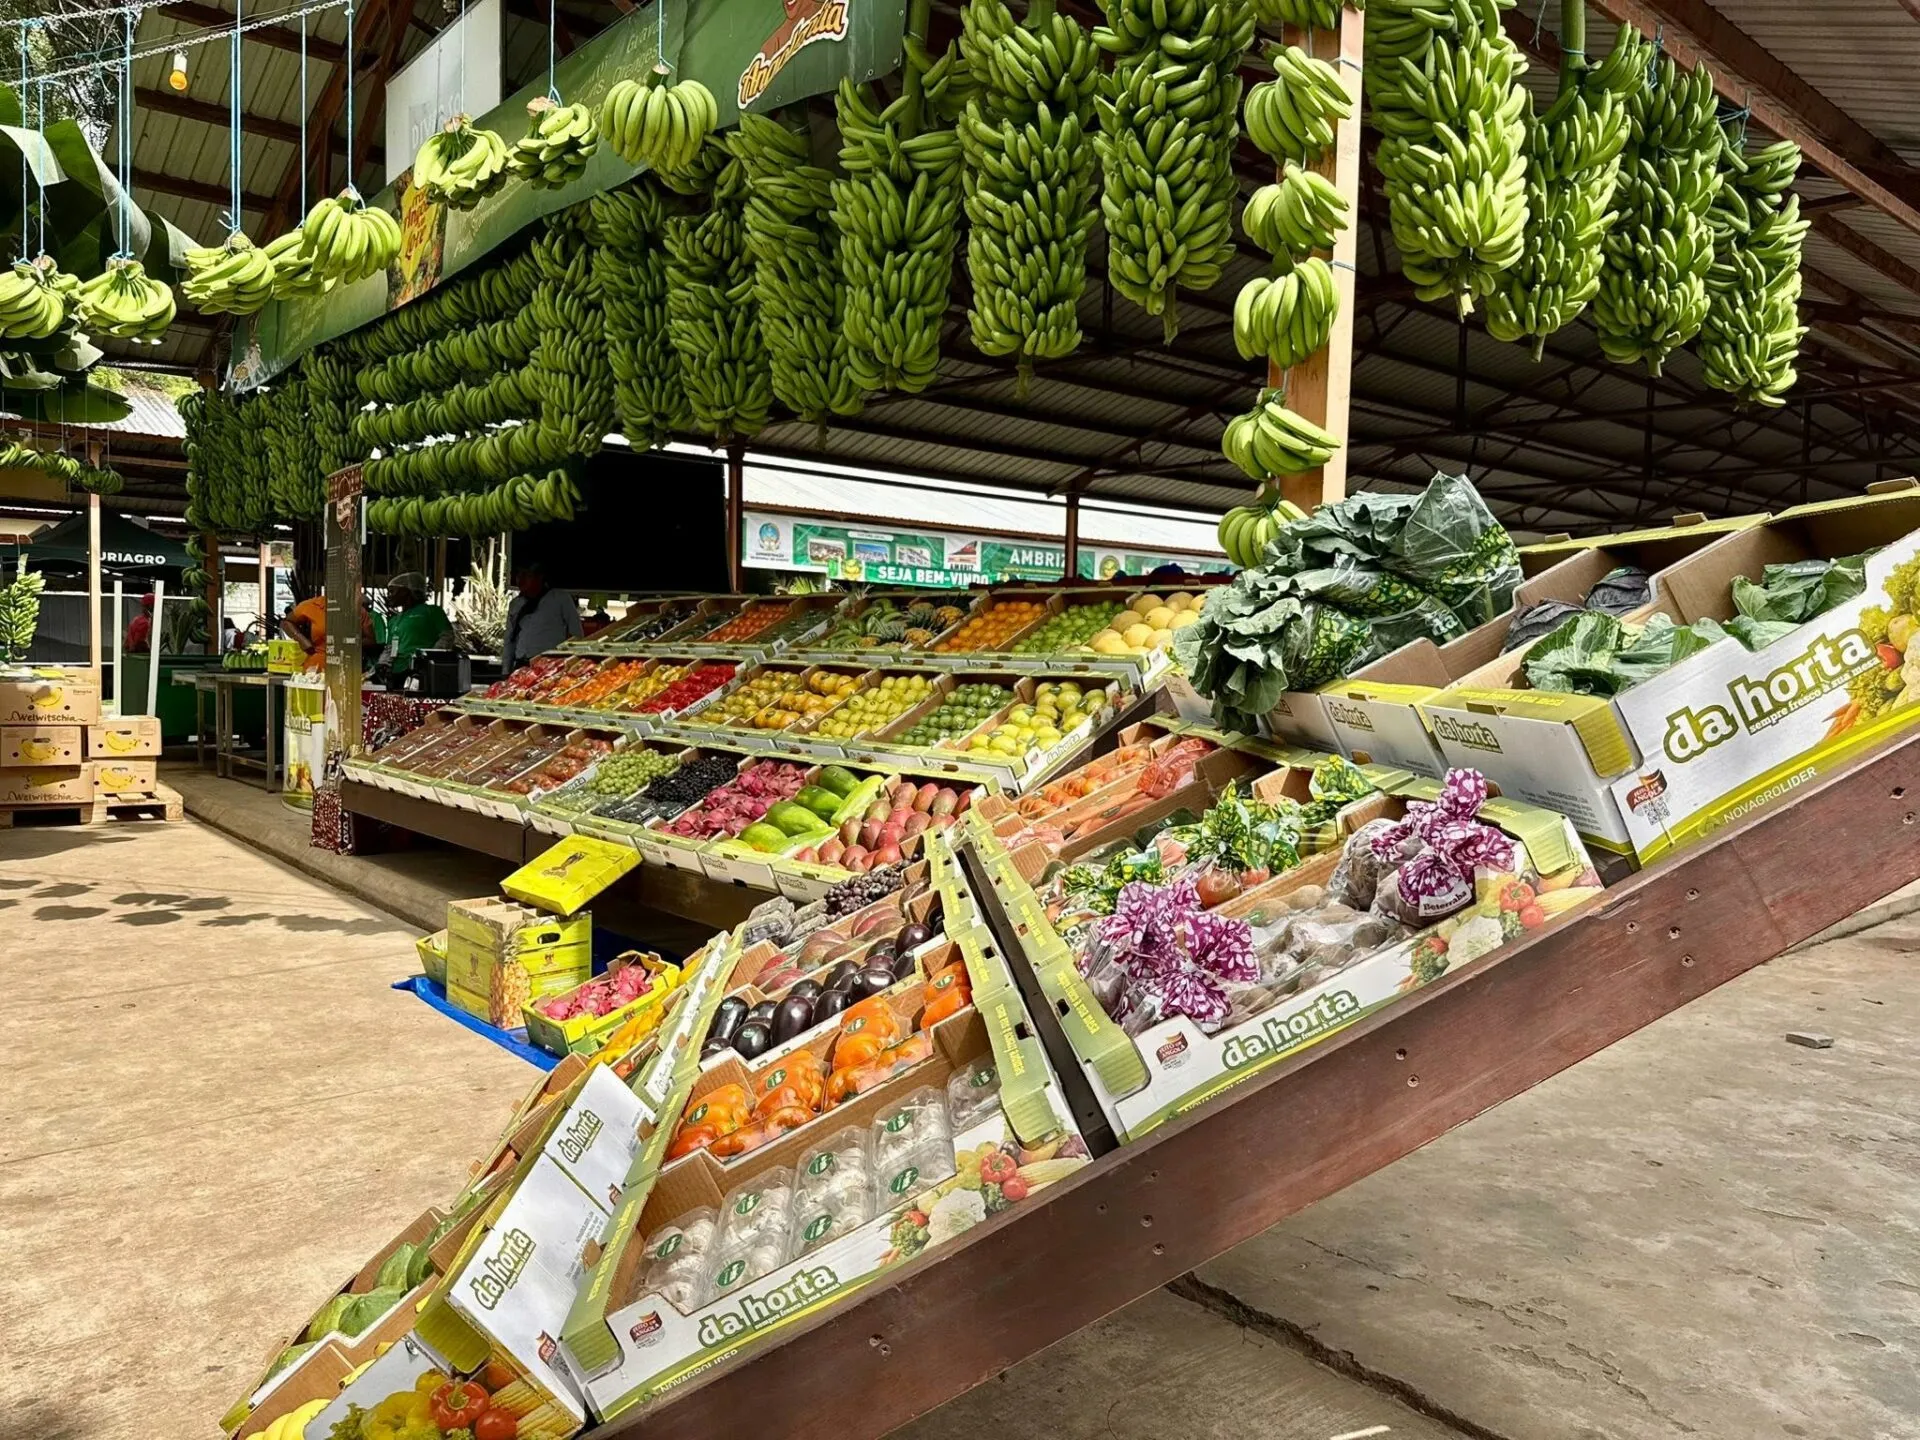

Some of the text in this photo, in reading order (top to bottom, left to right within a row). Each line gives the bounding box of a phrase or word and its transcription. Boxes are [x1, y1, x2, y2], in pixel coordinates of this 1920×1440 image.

[86, 551, 166, 565] URIAGRO
[878, 566, 912, 582] SEJA
[1667, 632, 1874, 760] da horta
[1434, 716, 1499, 746] da horta
[1723, 766, 1817, 825] NOVAGROLIDER
[1423, 891, 1467, 911] Beterraba
[1223, 990, 1357, 1068] da horta
[558, 1110, 599, 1162] da horta
[471, 1230, 530, 1307] da horta
[699, 1266, 834, 1346] da horta
